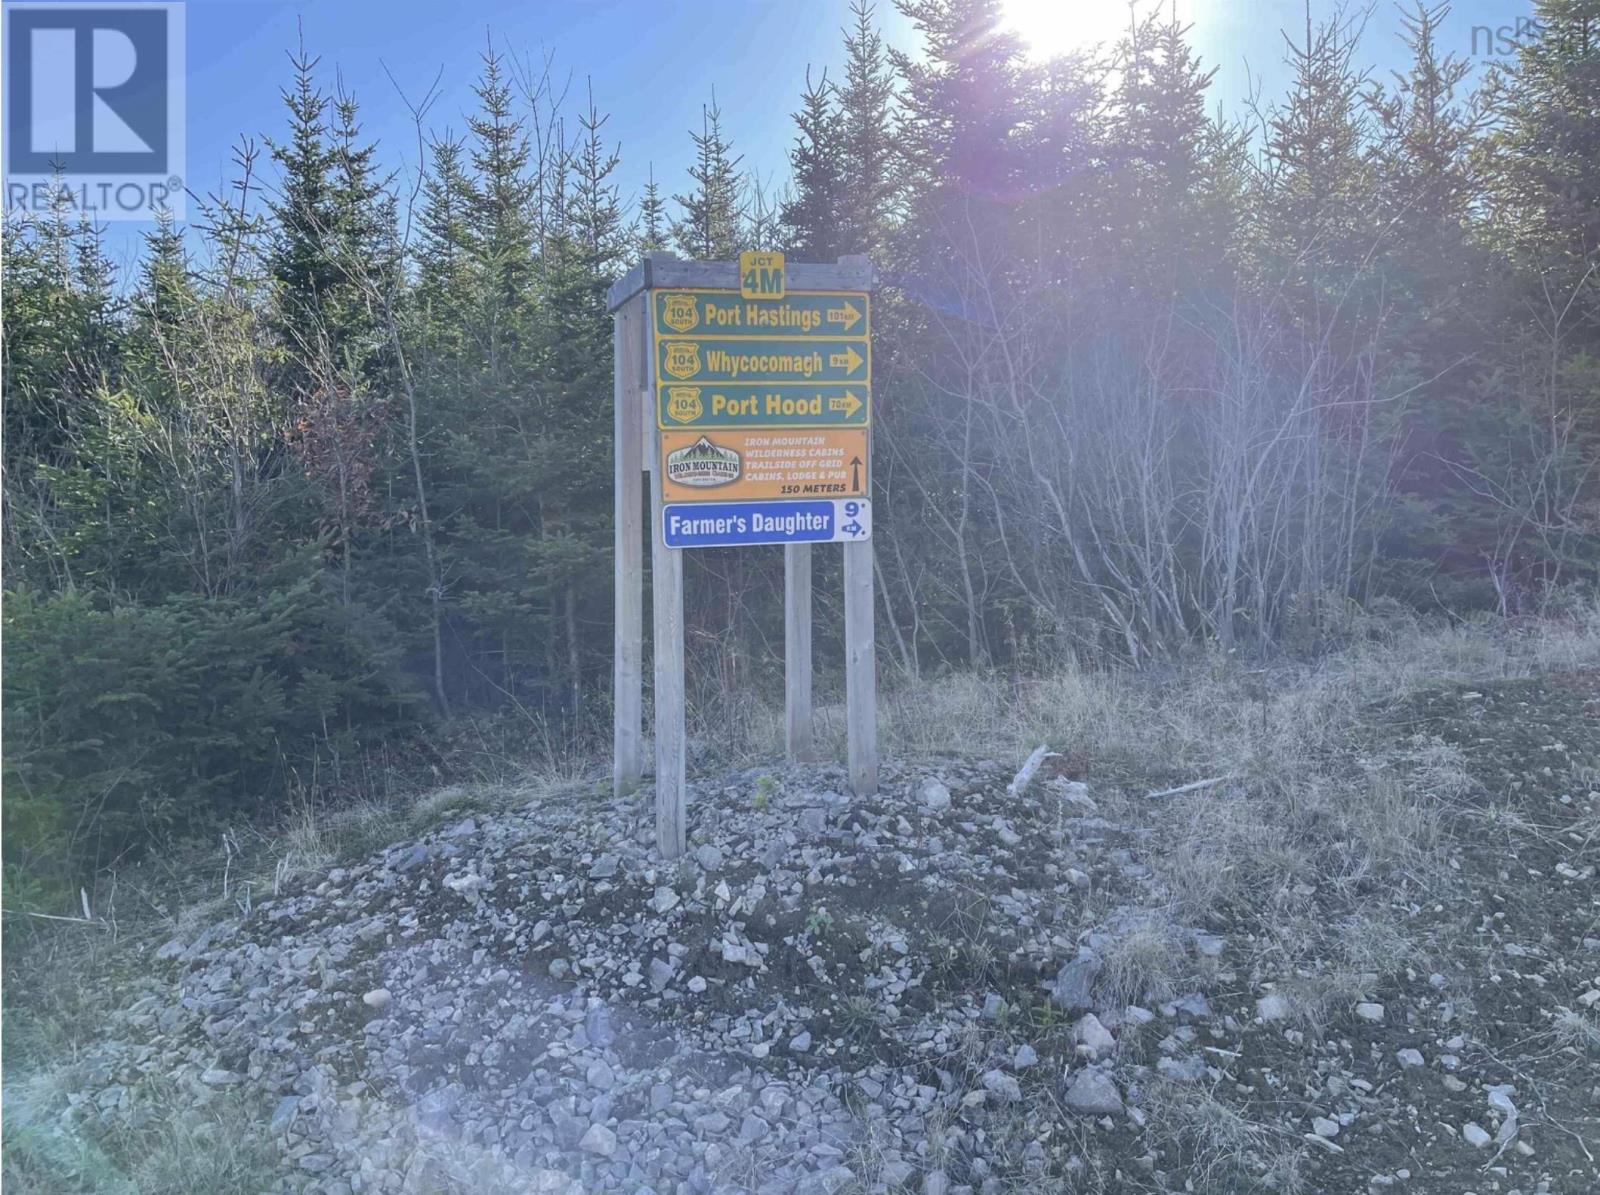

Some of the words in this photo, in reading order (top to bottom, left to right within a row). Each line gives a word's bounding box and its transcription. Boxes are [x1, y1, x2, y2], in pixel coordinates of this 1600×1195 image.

[750, 257, 773, 266] JCT
[742, 268, 784, 294] 4M
[671, 307, 693, 318] 104
[705, 303, 741, 326] Port
[746, 304, 821, 331] Hastings
[672, 354, 695, 366] 104
[706, 350, 823, 378] Whycocomagh
[675, 399, 697, 410] 104
[712, 394, 759, 416] Port
[766, 394, 822, 416] Hood
[745, 438, 769, 446] IRON
[772, 437, 826, 446] MOUNTAIN
[745, 449, 806, 458] WILDERNESS
[809, 448, 845, 456] CABINS
[669, 461, 691, 474] IRON
[693, 461, 738, 473] MOUNTAIN
[745, 460, 796, 469] TRAILSIDE
[799, 459, 818, 467] OFF
[819, 459, 843, 467] GRID
[787, 471, 817, 479] LODGE
[827, 470, 848, 479] PUB
[781, 485, 801, 494] 150
[803, 483, 847, 493] METERS
[845, 501, 859, 517] 9
[670, 515, 747, 535] Farmer's
[752, 512, 830, 534] Daughter
